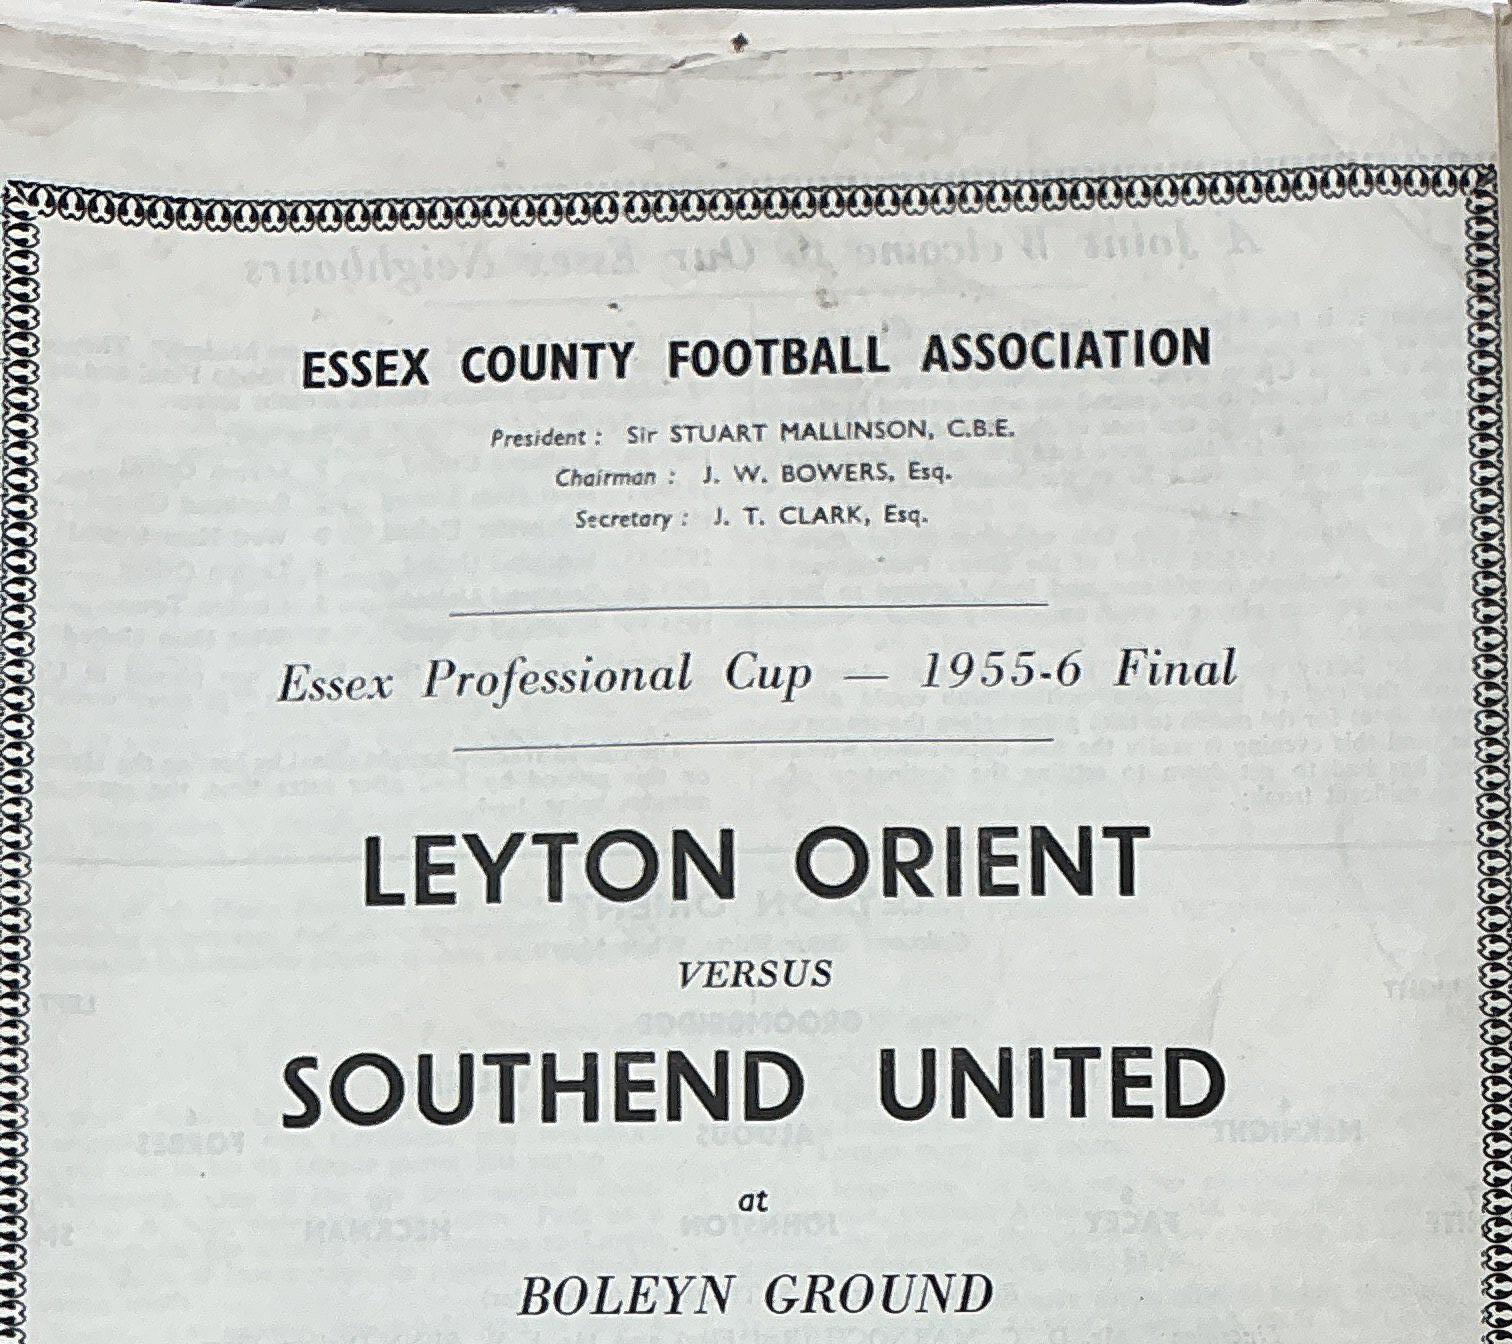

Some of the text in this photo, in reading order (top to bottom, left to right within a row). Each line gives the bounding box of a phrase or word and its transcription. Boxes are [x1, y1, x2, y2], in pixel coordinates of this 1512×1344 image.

[302, 326, 1211, 390] ESSEX COUNTY FOOTBALL ASSOCIATION
[626, 418, 1015, 445] Sir STUART MALLINSON, C.B.E.
[277, 646, 1238, 710] Essex Professional Cup 1955-6 Final
[364, 824, 1151, 907] LEYTON ORIENT
[678, 958, 833, 989] VERSUS
[281, 1046, 1226, 1129] SOUTHEND UNITED
[737, 1189, 769, 1213] at
[516, 1272, 994, 1317] BOLEYN GROUND
